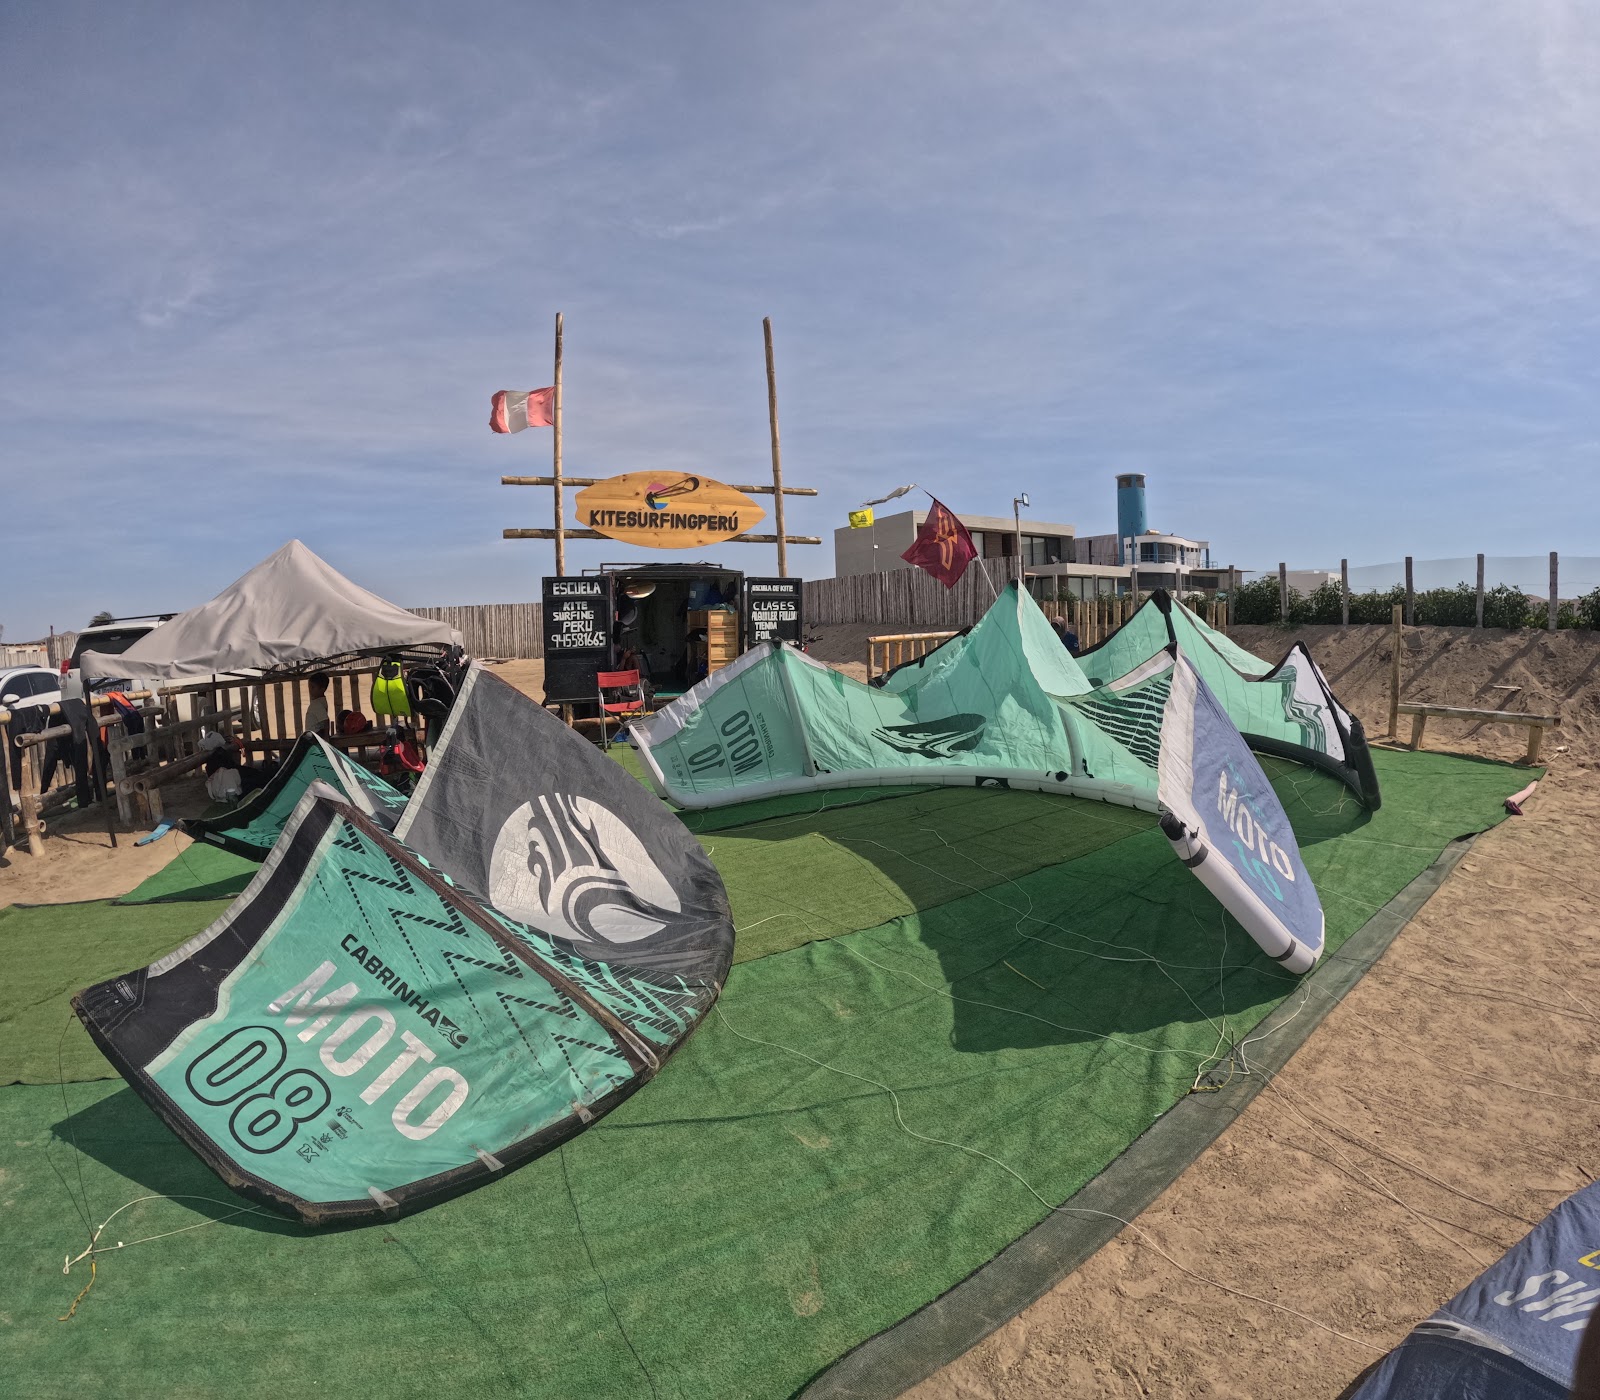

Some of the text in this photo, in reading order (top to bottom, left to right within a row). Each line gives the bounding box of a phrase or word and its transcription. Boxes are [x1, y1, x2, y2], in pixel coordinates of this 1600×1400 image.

[589, 509, 738, 532] KITESURFINGPERÚ
[553, 582, 601, 595] ESCUELA
[563, 601, 588, 611] KITE
[753, 601, 795, 610] CLASES
[553, 610, 594, 621] SURFING
[563, 620, 593, 633] PERU
[551, 631, 606, 648] 945581665
[755, 631, 771, 640] FOIL
[1217, 770, 1295, 882] MOTO
[341, 933, 441, 1028] CABRINHA
[267, 960, 469, 1140] MOTO
[185, 1025, 331, 1155] 08
